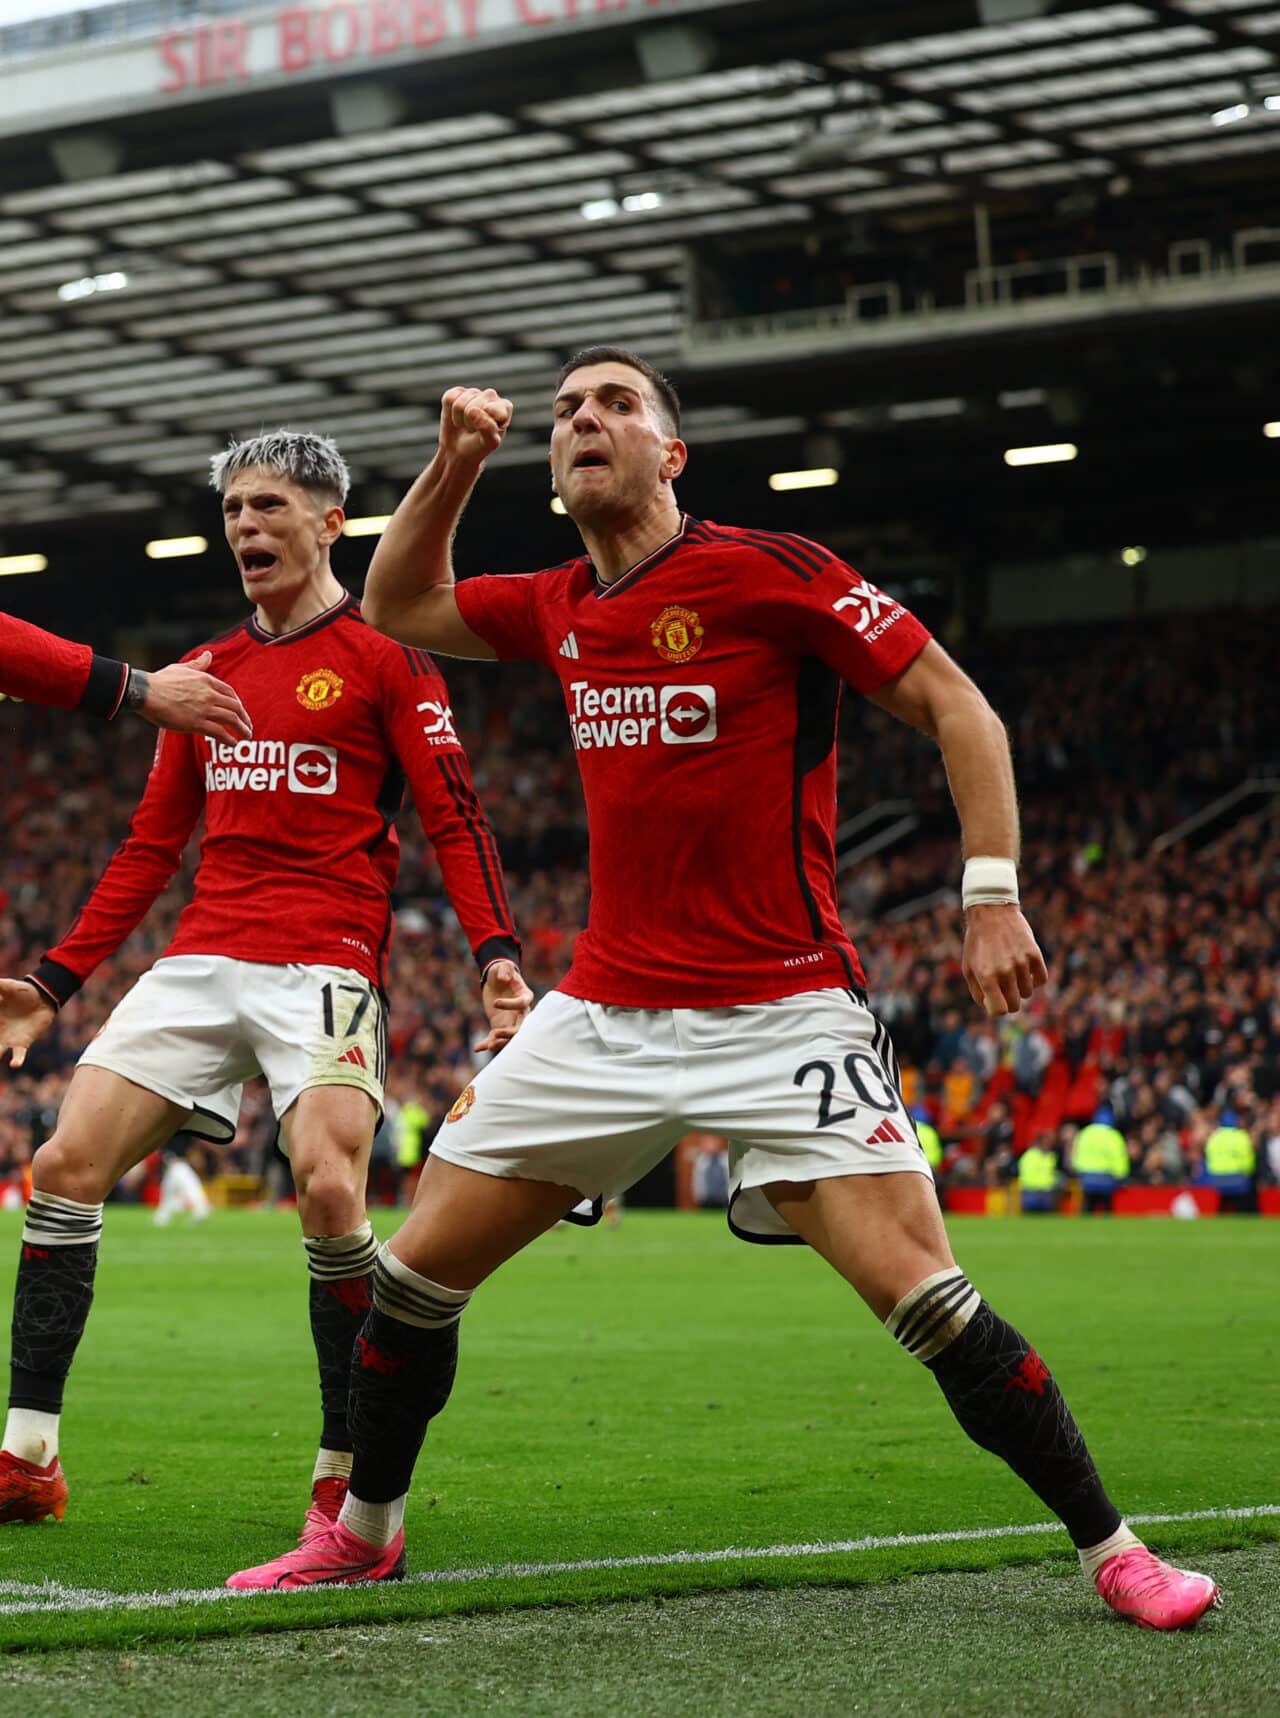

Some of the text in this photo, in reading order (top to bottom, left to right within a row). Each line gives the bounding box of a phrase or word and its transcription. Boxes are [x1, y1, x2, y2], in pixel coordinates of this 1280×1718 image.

[159, 0, 482, 93] SIR BOBBY
[570, 681, 656, 718] Team
[205, 736, 286, 764] Team
[783, 951, 824, 968] HEAT.RDY
[321, 983, 370, 1038] 17
[793, 1053, 898, 1128] 20
